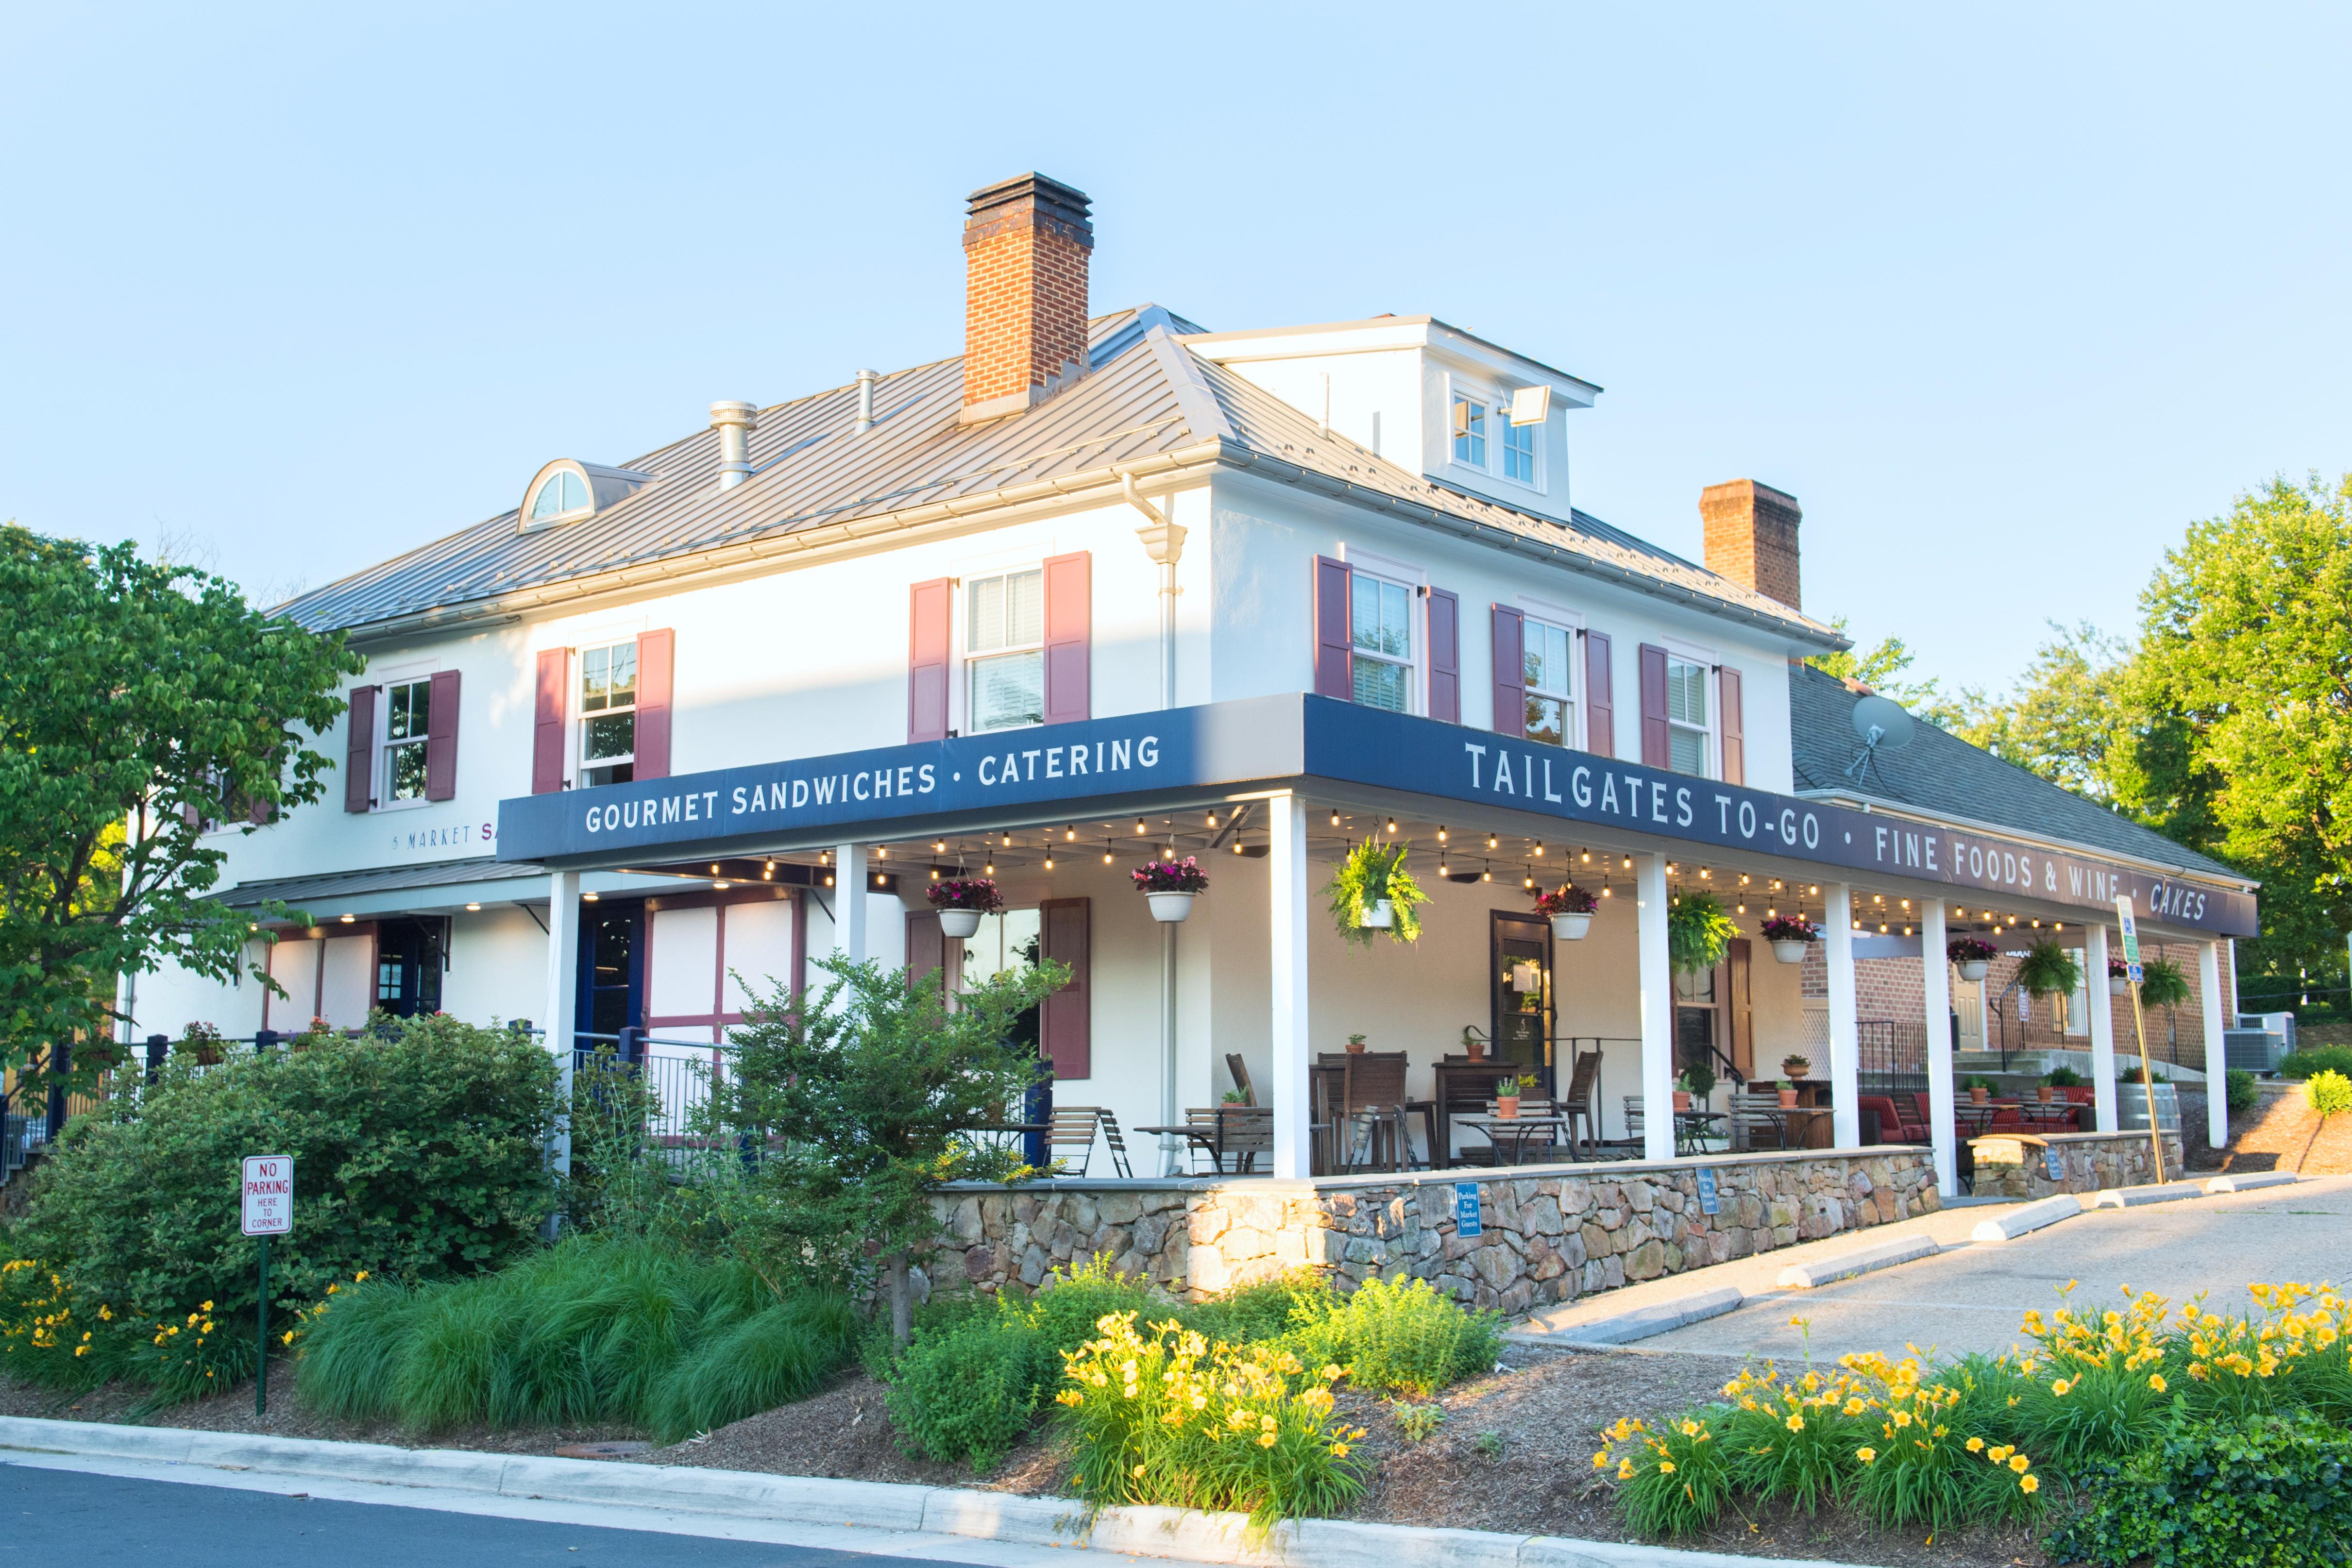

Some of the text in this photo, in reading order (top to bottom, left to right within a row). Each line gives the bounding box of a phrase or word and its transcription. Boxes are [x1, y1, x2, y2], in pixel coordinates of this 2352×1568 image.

[586, 736, 1159, 833] GOURMET SANDWICHES CATERING
[407, 823, 498, 850] MARKET S
[1465, 742, 2206, 921] TAILGATES TO-GO FINE FOODS & WINE CAKES
[259, 1163, 277, 1177] NO
[247, 1180, 288, 1196] PARKING
[258, 1197, 278, 1207] HERE
[1458, 1192, 1477, 1201] Parking
[263, 1208, 272, 1217] TO
[1460, 1210, 1477, 1218] Market
[252, 1218, 283, 1228] CORNER
